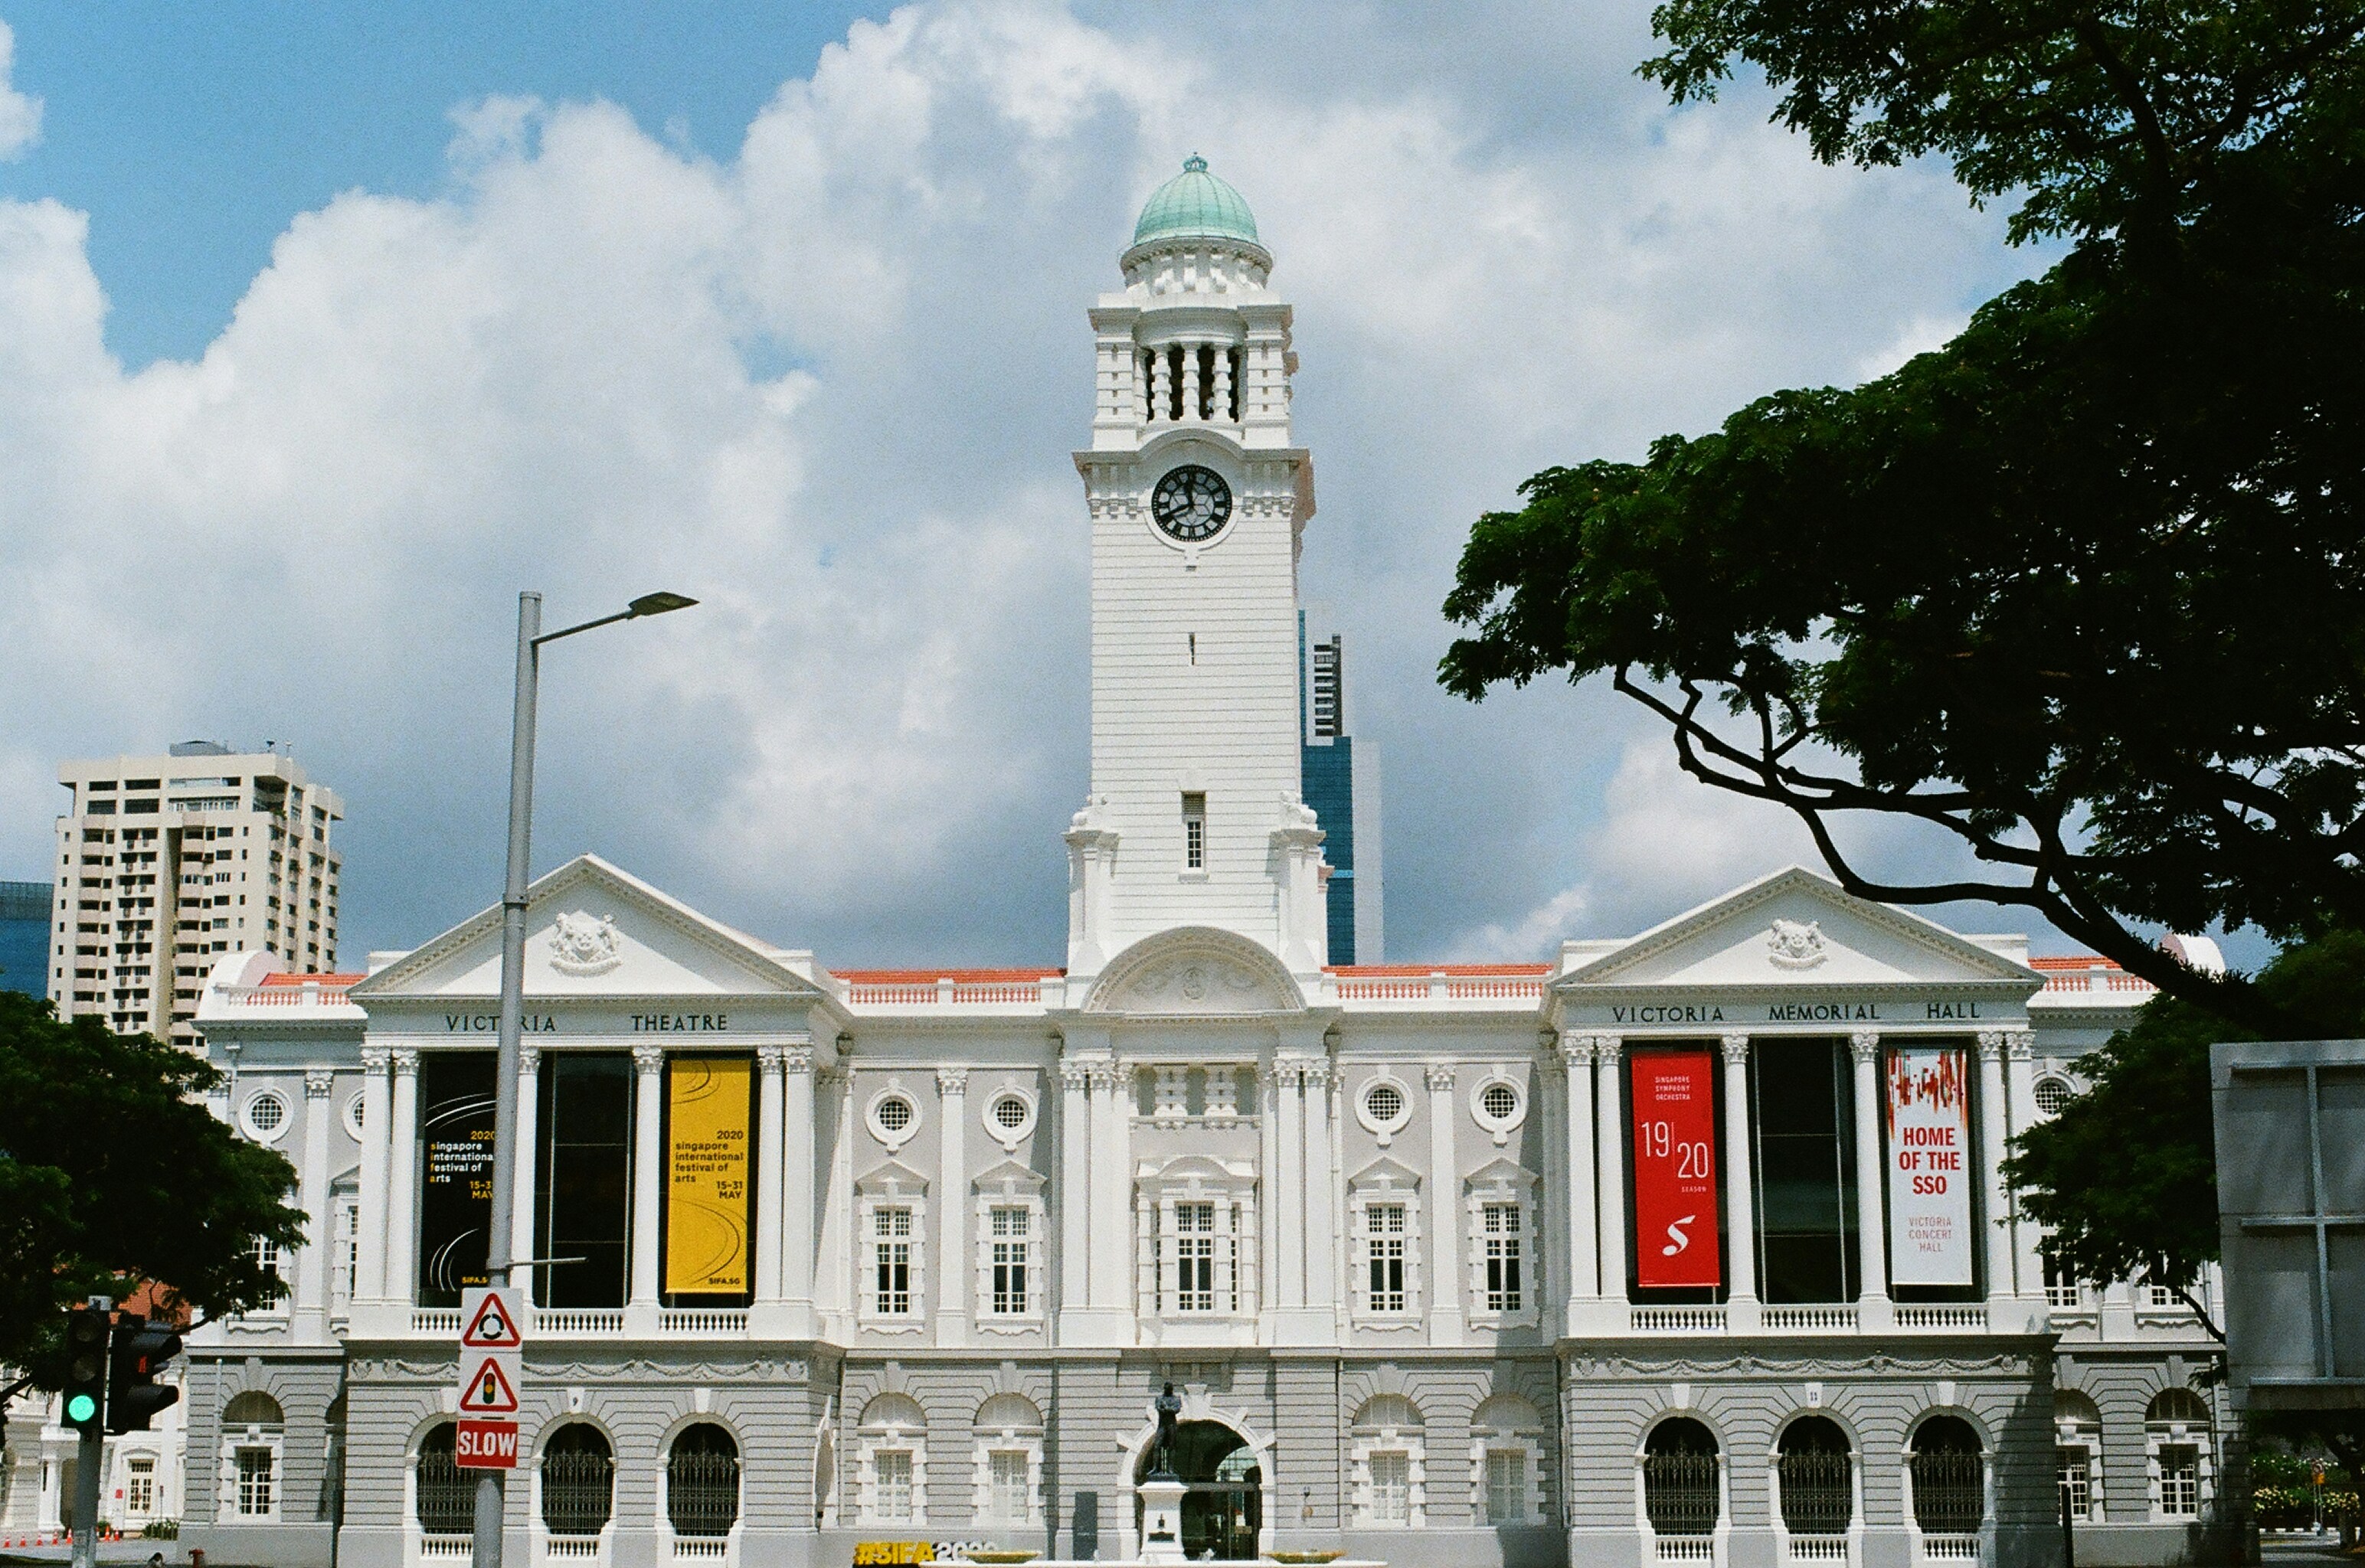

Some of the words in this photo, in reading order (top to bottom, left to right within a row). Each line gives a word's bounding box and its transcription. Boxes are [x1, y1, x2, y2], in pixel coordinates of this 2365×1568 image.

[1613, 1007, 1724, 1022] VICTORIA
[1768, 1004, 1880, 1021] MEMORIAL
[1927, 1003, 1981, 1019] HALL
[447, 1015, 556, 1031] VICTRIA
[631, 1014, 727, 1031] THEATRE
[717, 1130, 744, 1140] 2020
[1903, 1127, 1956, 1146] HOME
[430, 1142, 482, 1152] singapore
[675, 1142, 729, 1152] singapore
[1641, 1121, 1670, 1158] 19
[1677, 1142, 1709, 1178] 20
[430, 1152, 495, 1161] internationa
[675, 1152, 744, 1161] international
[1899, 1151, 1922, 1171] OF
[1926, 1151, 1961, 1171] THE
[430, 1162, 469, 1172] festival
[471, 1162, 482, 1172] of
[675, 1163, 715, 1172] festival
[718, 1163, 728, 1172] of
[430, 1174, 451, 1183] arts
[675, 1174, 696, 1183] arts
[469, 1181, 492, 1190] 15-3
[717, 1181, 743, 1190] 15-31
[1912, 1175, 1948, 1195] SSO
[718, 1191, 741, 1200] MAY
[1909, 1217, 1952, 1227] VICTORIA
[1909, 1229, 1952, 1240] CONCERT
[1919, 1242, 1944, 1253] HALL
[459, 1430, 517, 1457] SLOW
